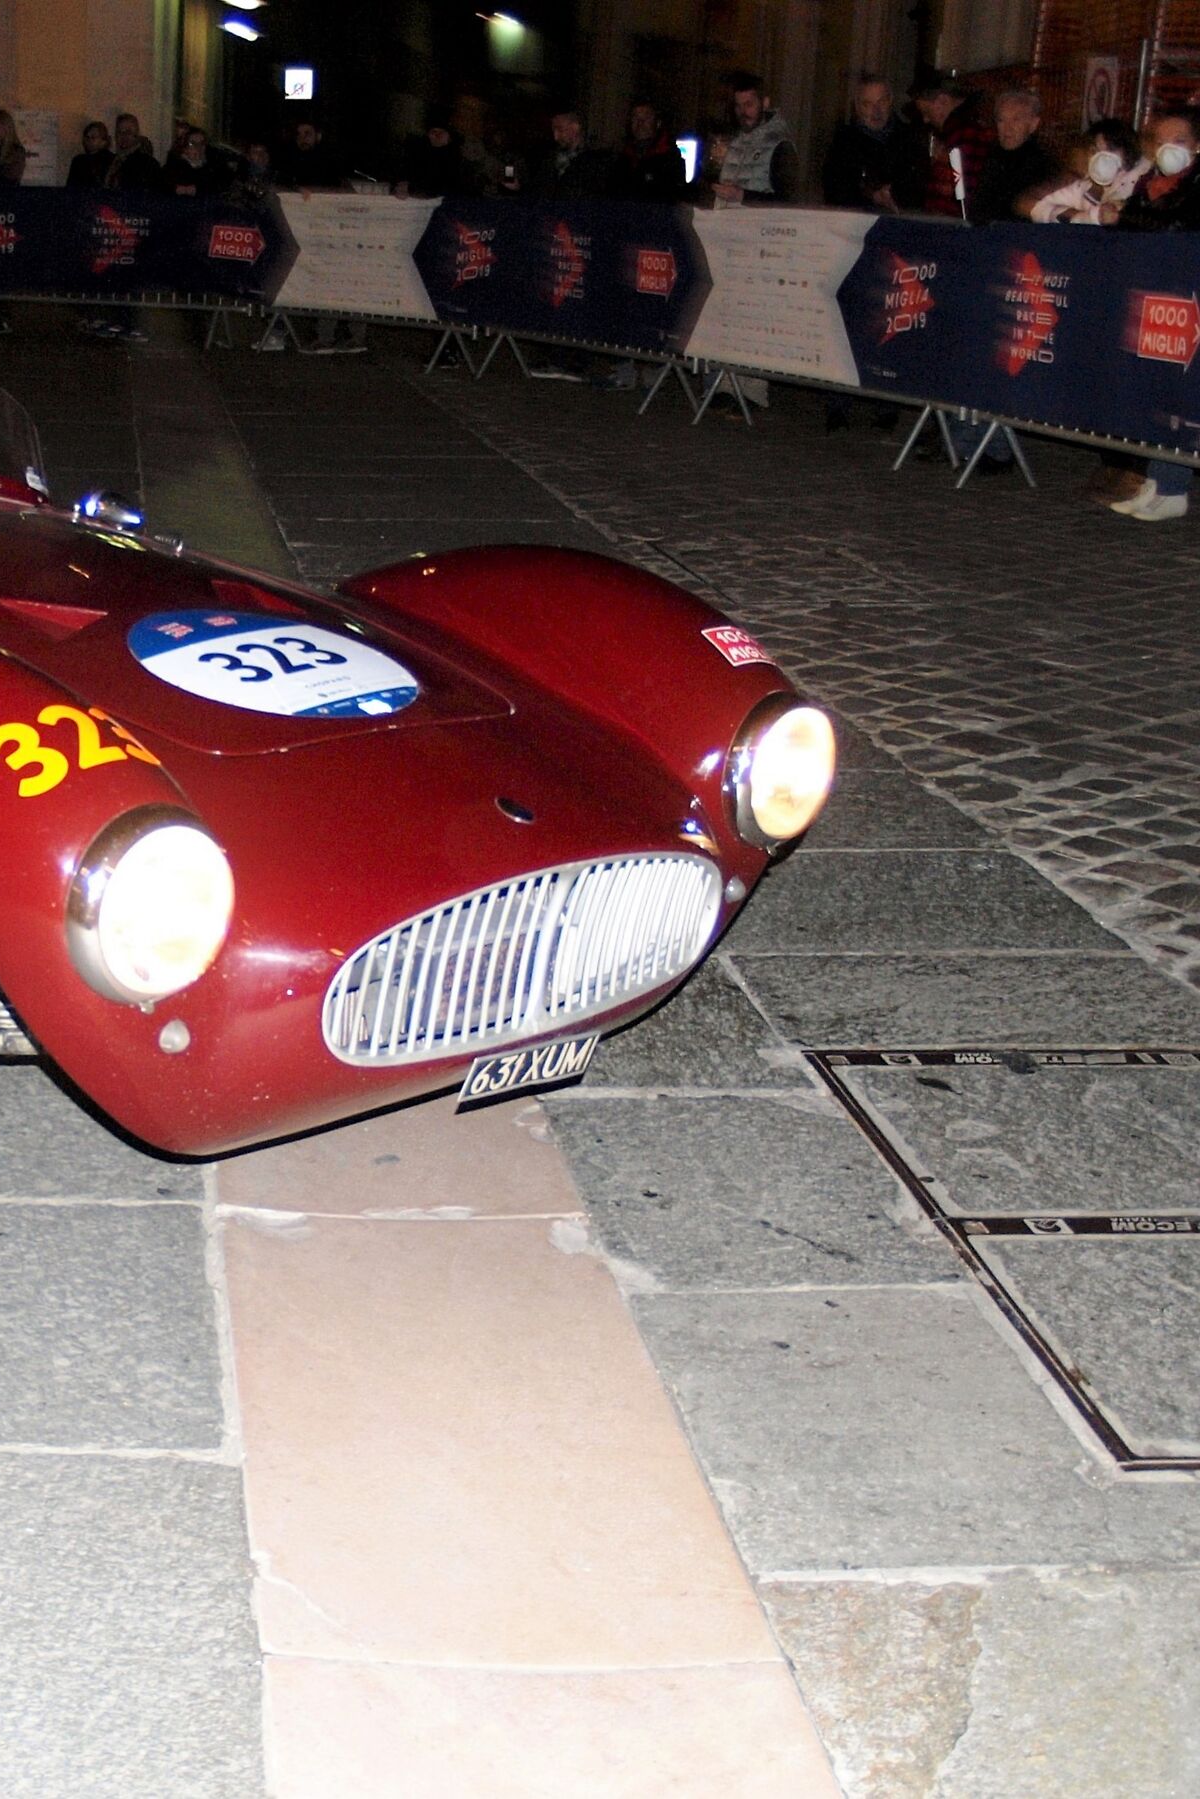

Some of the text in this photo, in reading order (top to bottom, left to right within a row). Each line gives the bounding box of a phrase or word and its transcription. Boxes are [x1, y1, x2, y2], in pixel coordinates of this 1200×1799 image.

[218, 229, 255, 244] 1000
[459, 227, 496, 246] 1000
[212, 243, 255, 259] MIGLIA
[455, 246, 493, 266] MIGLIA
[456, 263, 491, 283] 2019
[641, 256, 669, 272] 1000
[891, 262, 937, 285] 1000
[638, 274, 669, 291] MIGLIA
[1043, 274, 1071, 288] MOST
[884, 287, 930, 310] MIGLIA
[1004, 289, 1069, 308] BEAUTIFUL
[886, 312, 927, 334] 2019
[1016, 310, 1053, 326] RACE
[1148, 304, 1189, 328] 1000
[1012, 328, 1024, 340] IN
[1141, 331, 1187, 357] MIGLIA
[1009, 346, 1055, 364] WORLD
[715, 630, 759, 646] 100
[197, 636, 348, 684] 323
